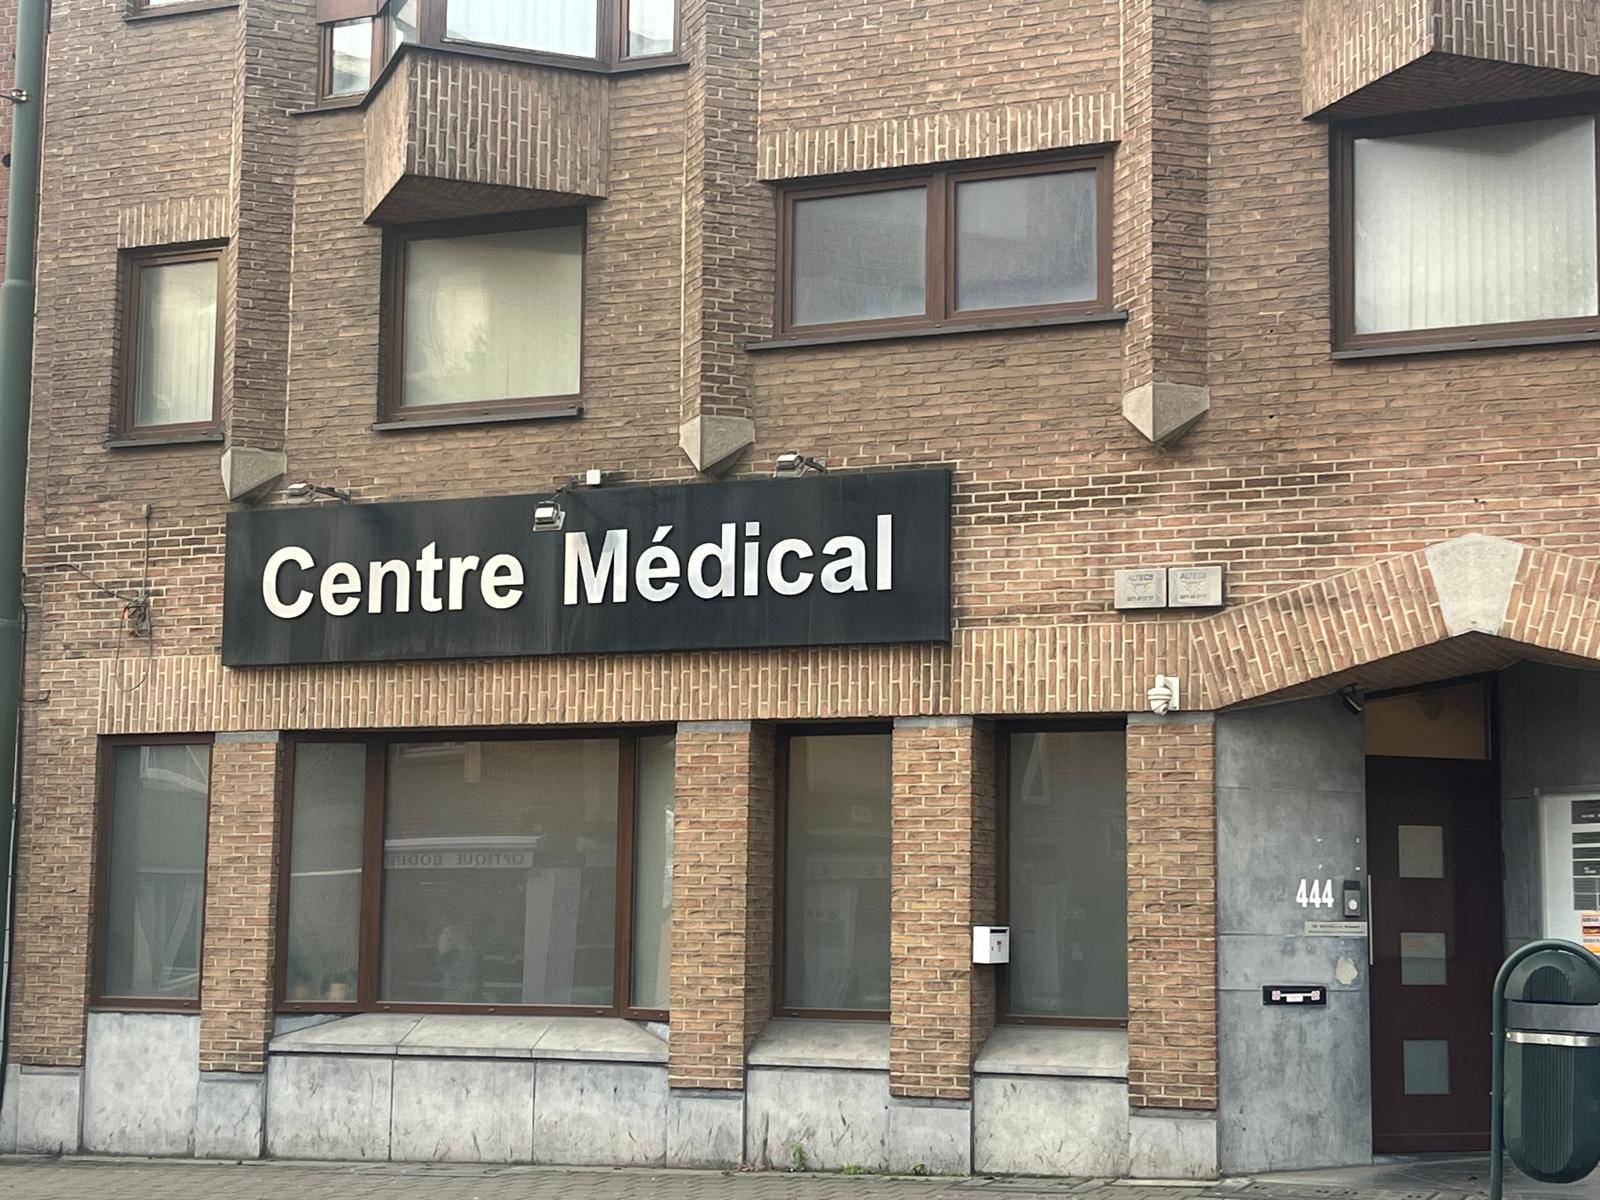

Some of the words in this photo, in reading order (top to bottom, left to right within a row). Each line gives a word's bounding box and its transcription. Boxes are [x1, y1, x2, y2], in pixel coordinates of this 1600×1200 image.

[262, 541, 524, 619] Centre
[563, 513, 893, 606] Médical
[1296, 878, 1335, 908] 444
